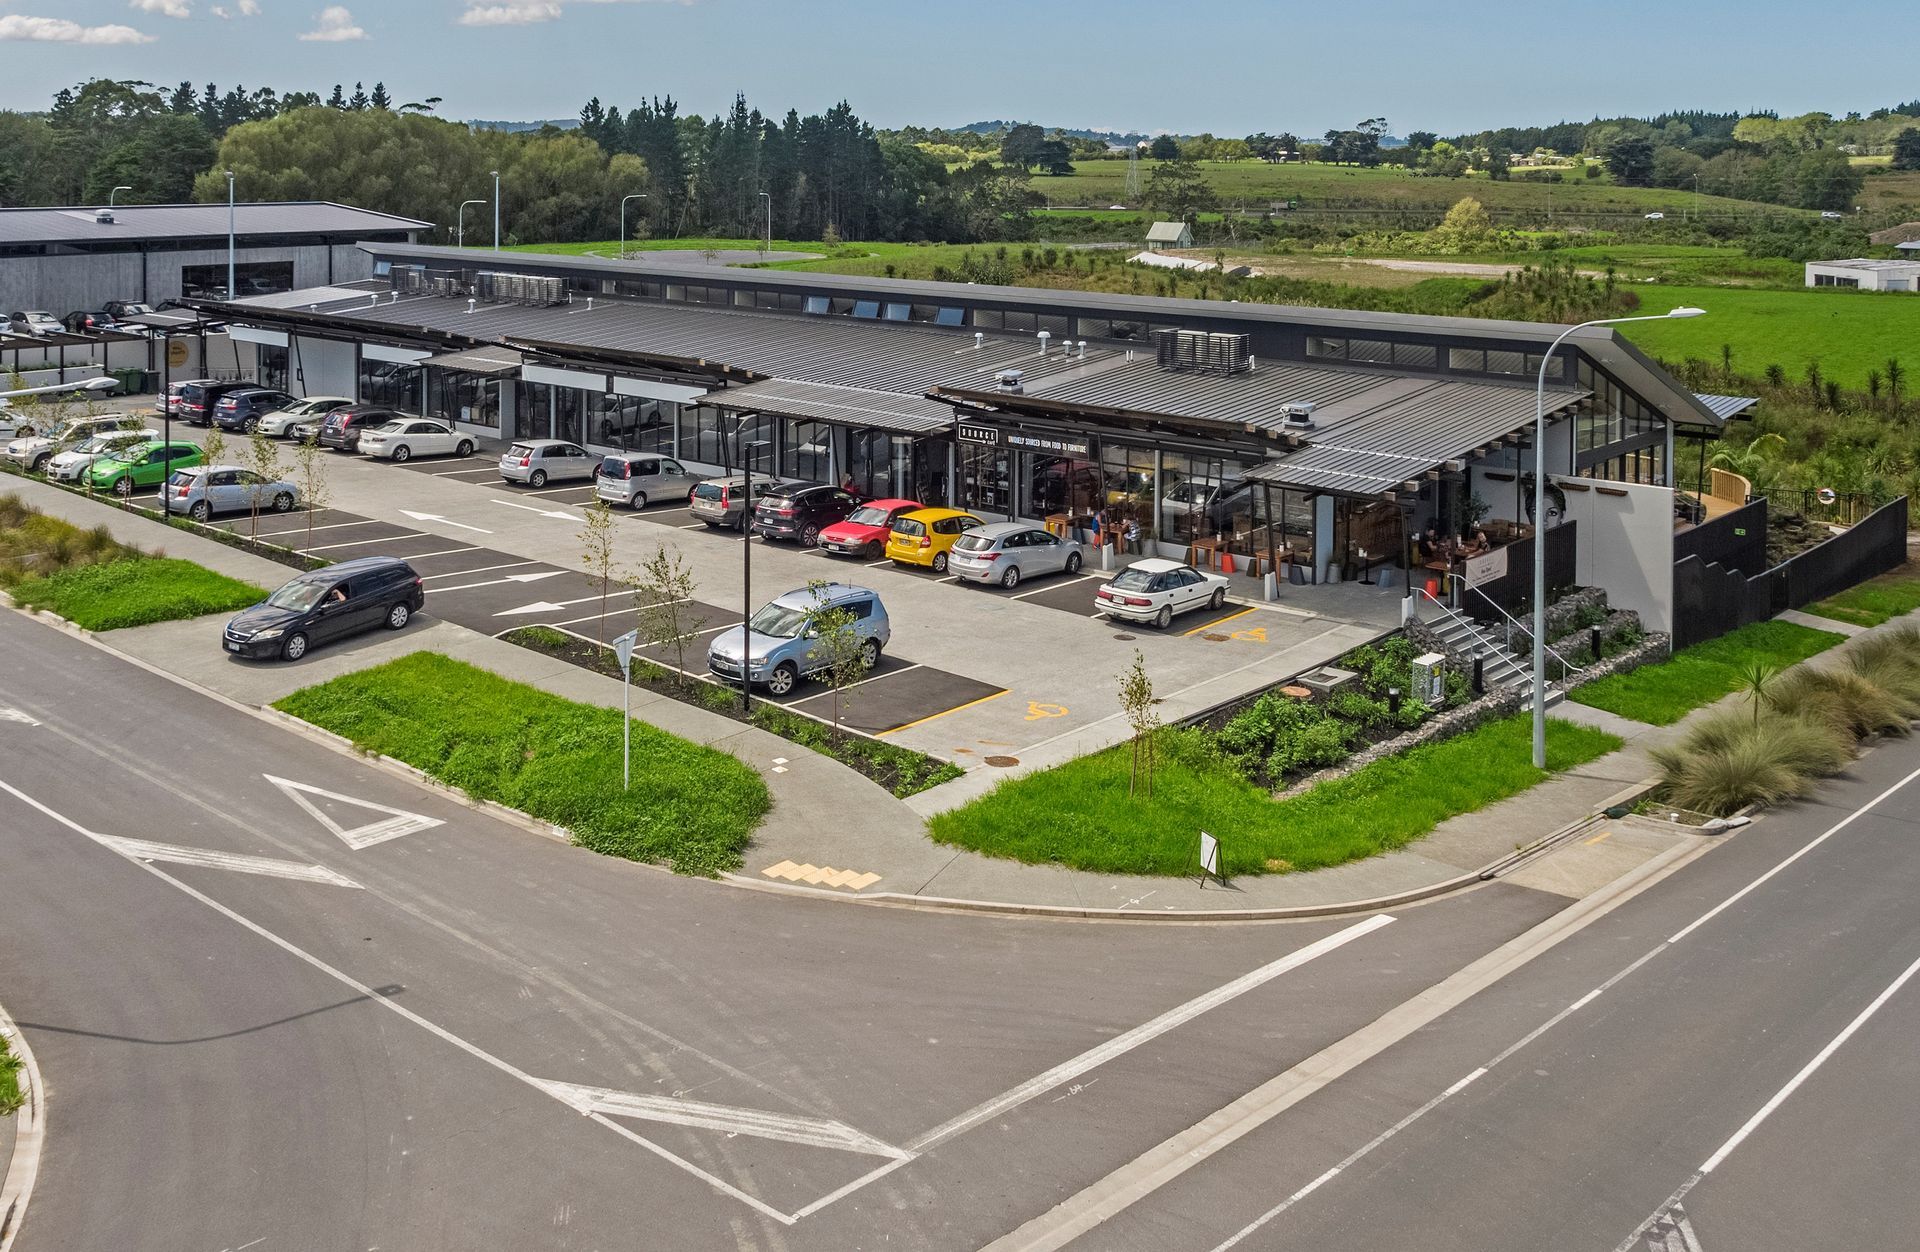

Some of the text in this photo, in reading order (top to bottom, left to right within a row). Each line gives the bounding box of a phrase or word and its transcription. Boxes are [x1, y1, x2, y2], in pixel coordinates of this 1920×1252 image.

[962, 428, 994, 440] SOURCE
[1025, 437, 1040, 447] SOURCED
[1041, 439, 1051, 448] FROM
[1052, 441, 1061, 450] FOOD
[1067, 443, 1087, 454] FURNITURE
